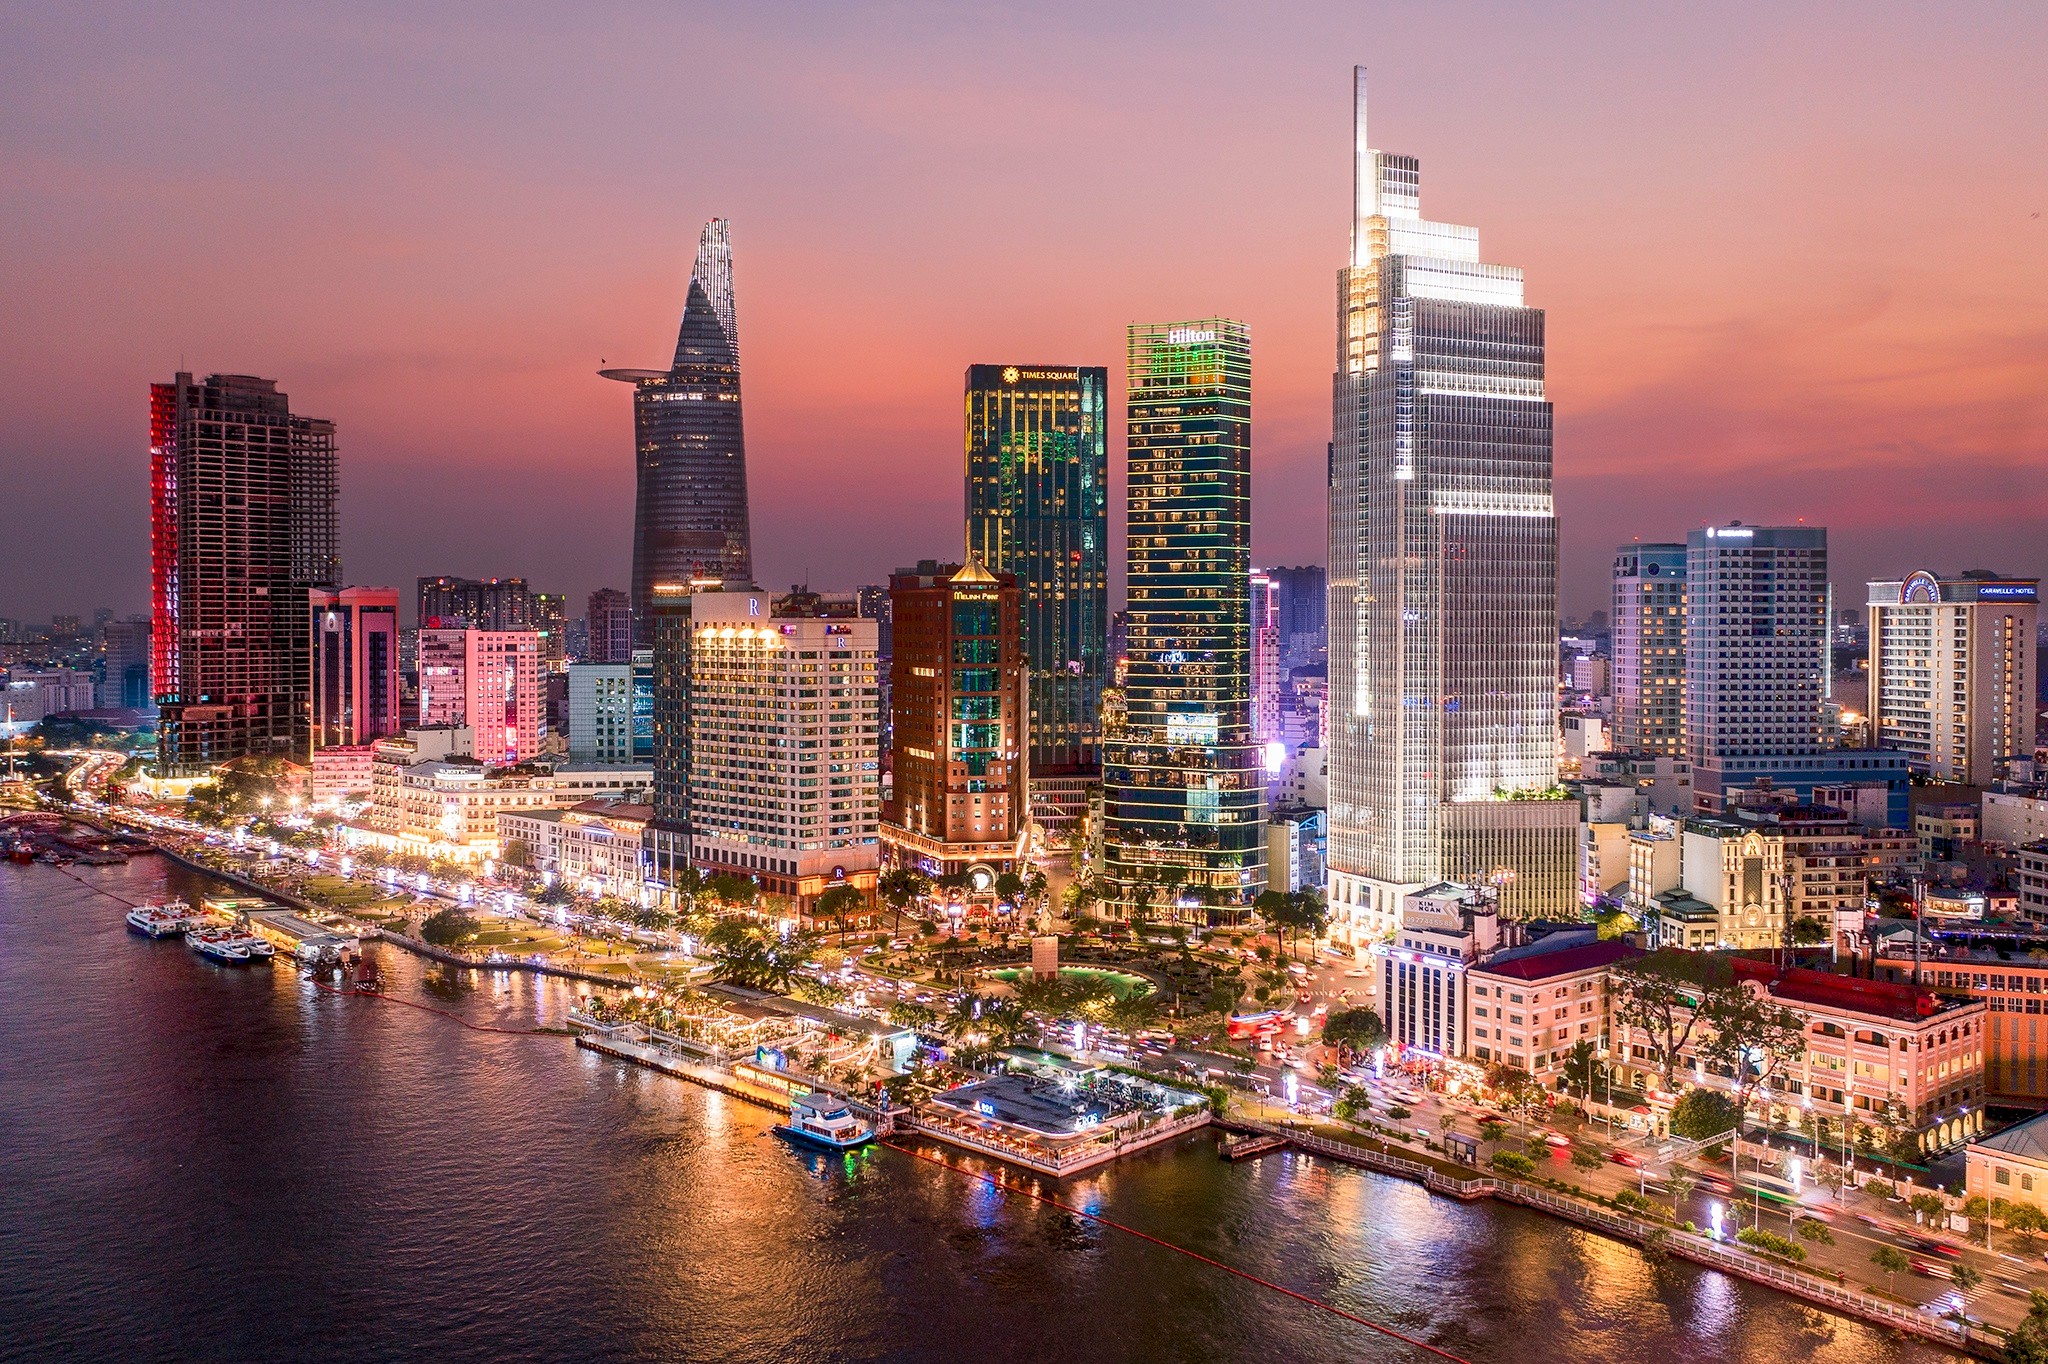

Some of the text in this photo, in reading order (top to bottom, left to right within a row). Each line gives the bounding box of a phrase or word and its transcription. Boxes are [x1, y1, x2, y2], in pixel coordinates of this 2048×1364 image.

[1169, 329, 1215, 344] Hilton
[1022, 371, 1079, 380] TIMES SQUARE
[749, 598, 760, 616] R
[837, 637, 846, 648] R
[836, 868, 843, 878] R
